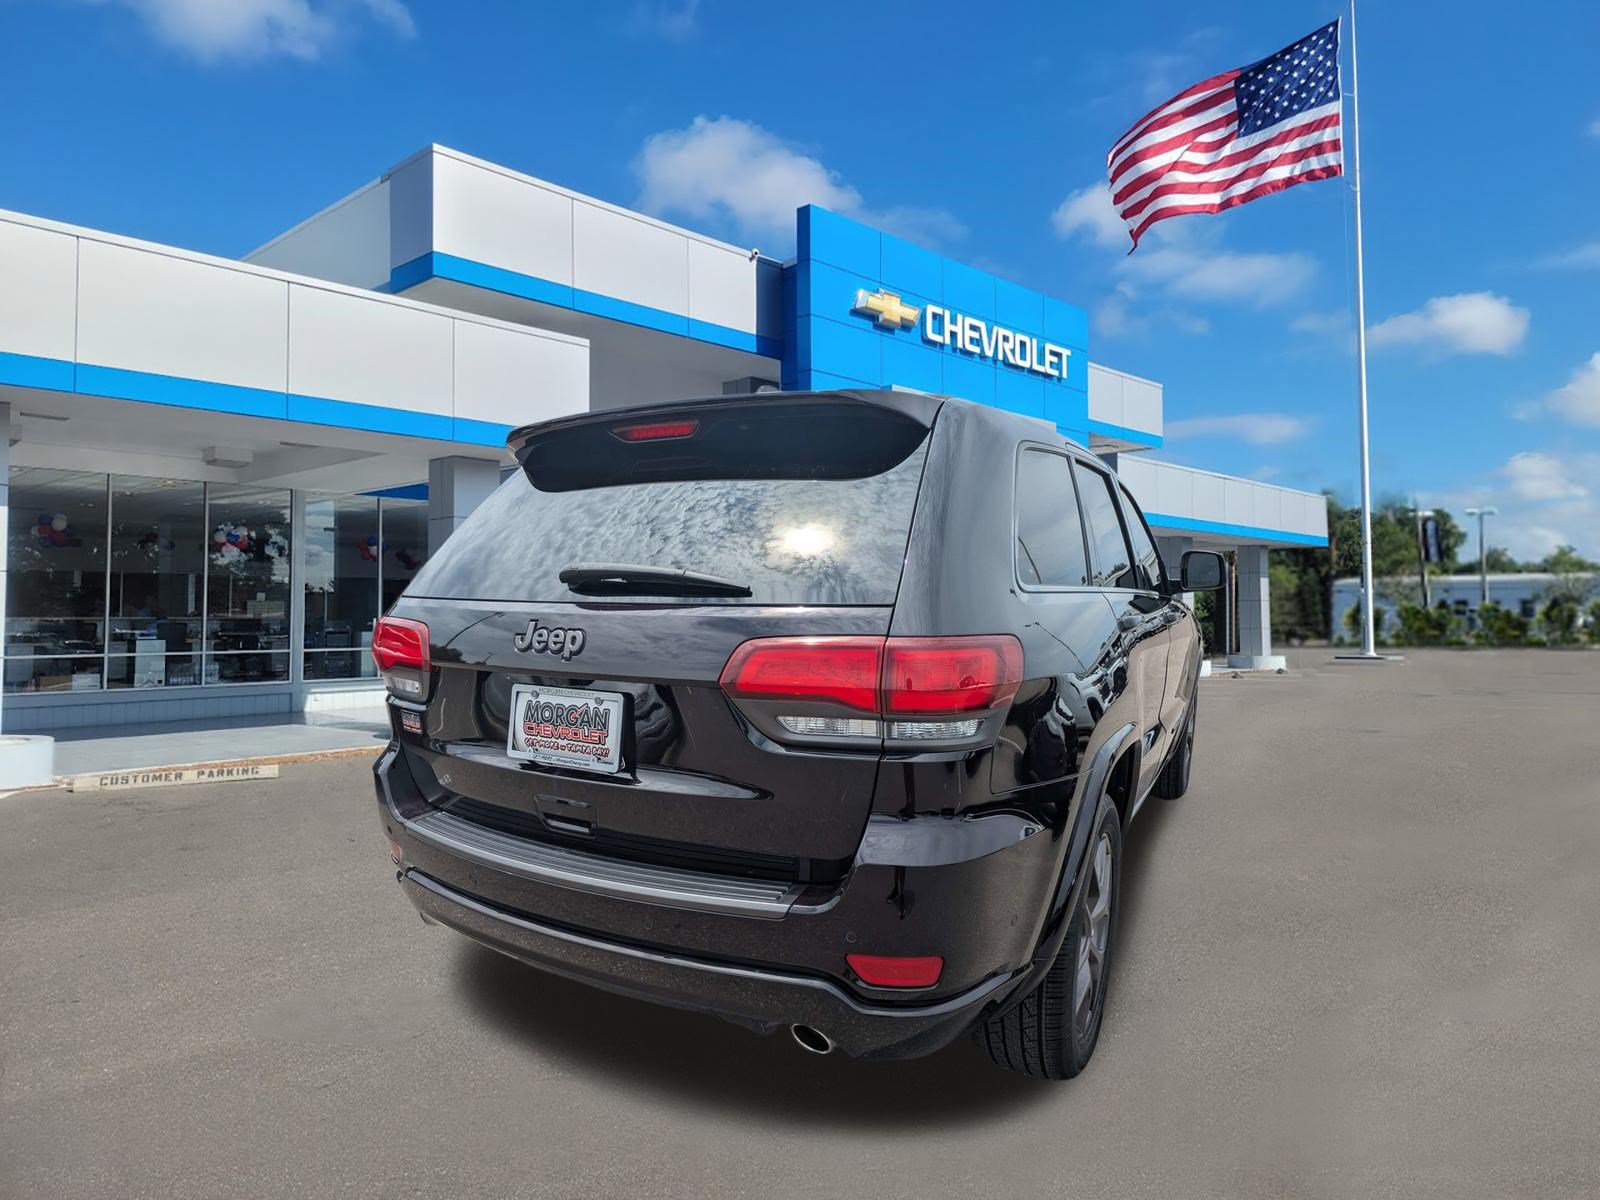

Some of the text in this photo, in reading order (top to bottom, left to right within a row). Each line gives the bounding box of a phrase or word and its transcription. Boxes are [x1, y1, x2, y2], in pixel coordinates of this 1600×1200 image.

[924, 304, 1072, 379] CHEVROLET
[514, 618, 586, 662] Jeep
[539, 687, 563, 695] MORGAN
[524, 700, 610, 730] MORGAN
[523, 722, 608, 746] CHEVROLET
[538, 740, 559, 751] MORE
[566, 743, 591, 755] TAMPA
[99, 766, 260, 787] CUSTOMER PARKING
